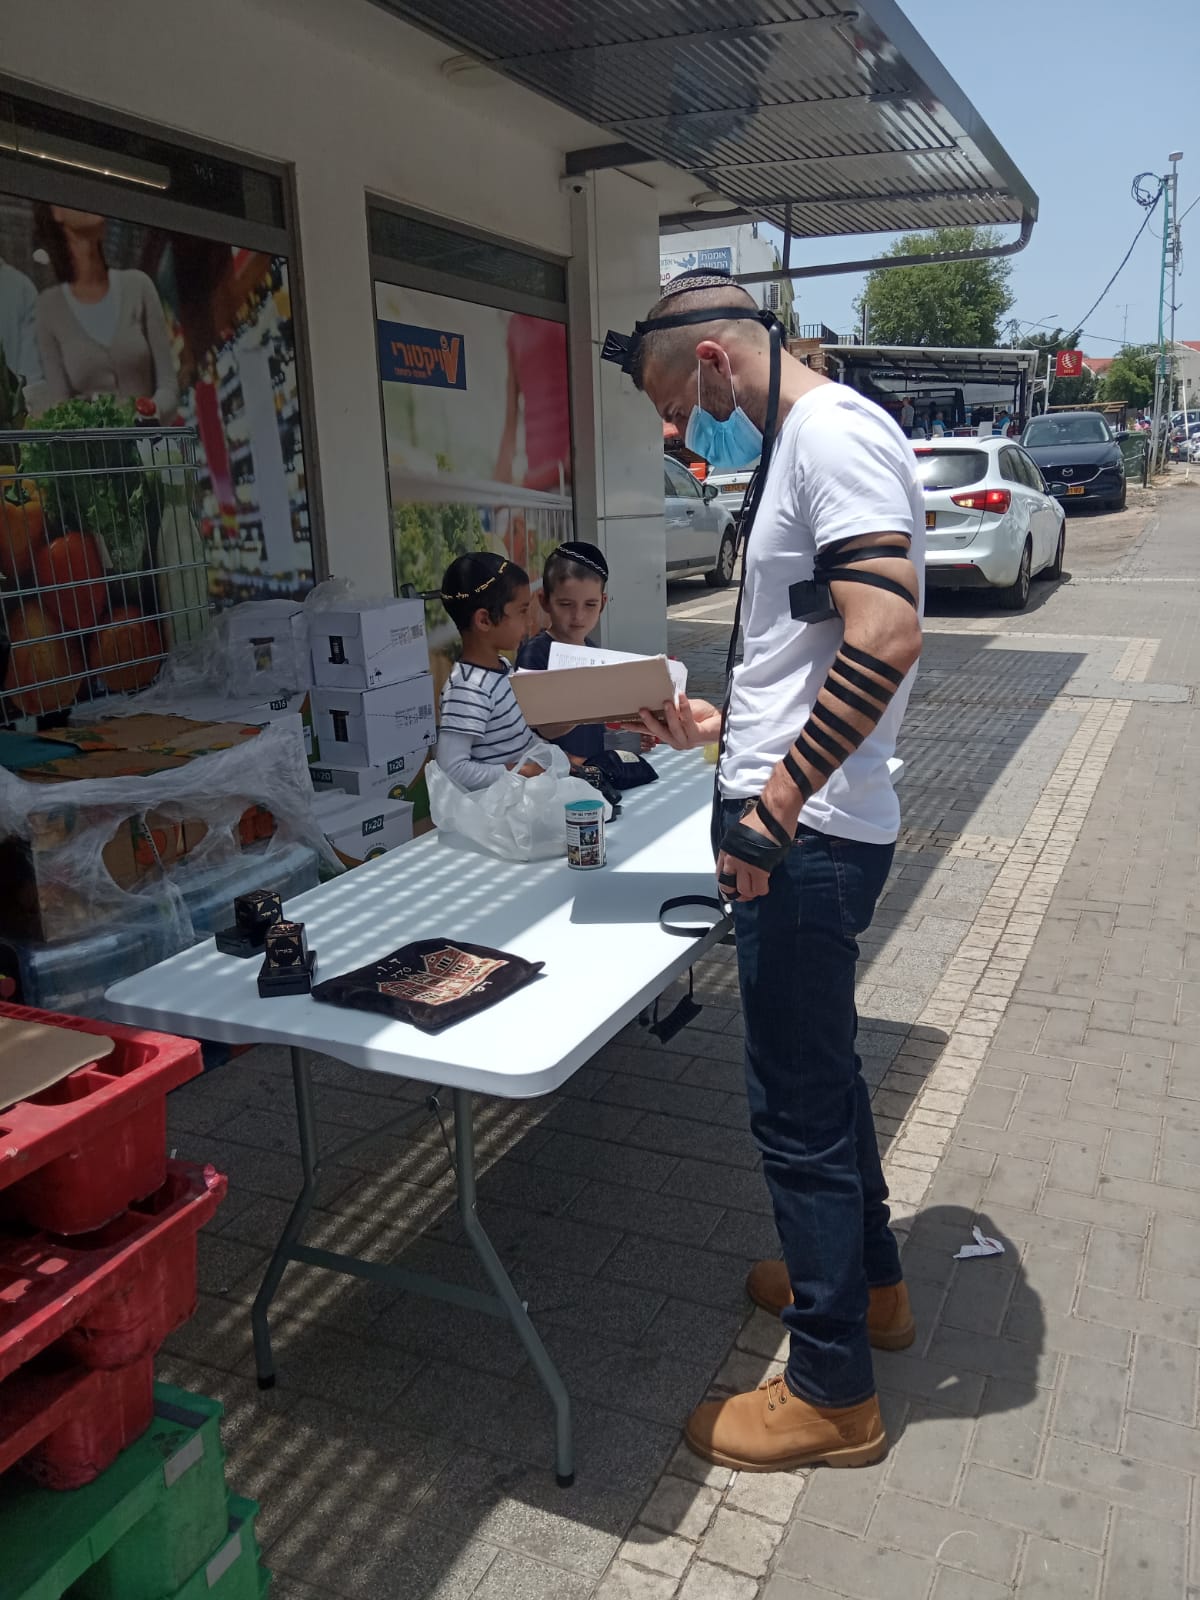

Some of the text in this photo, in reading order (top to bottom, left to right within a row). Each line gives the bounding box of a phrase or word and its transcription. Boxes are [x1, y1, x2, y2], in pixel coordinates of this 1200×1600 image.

[388, 758, 404, 772] 1x20
[364, 817, 383, 833] 1x20
[390, 966, 412, 979] 770
